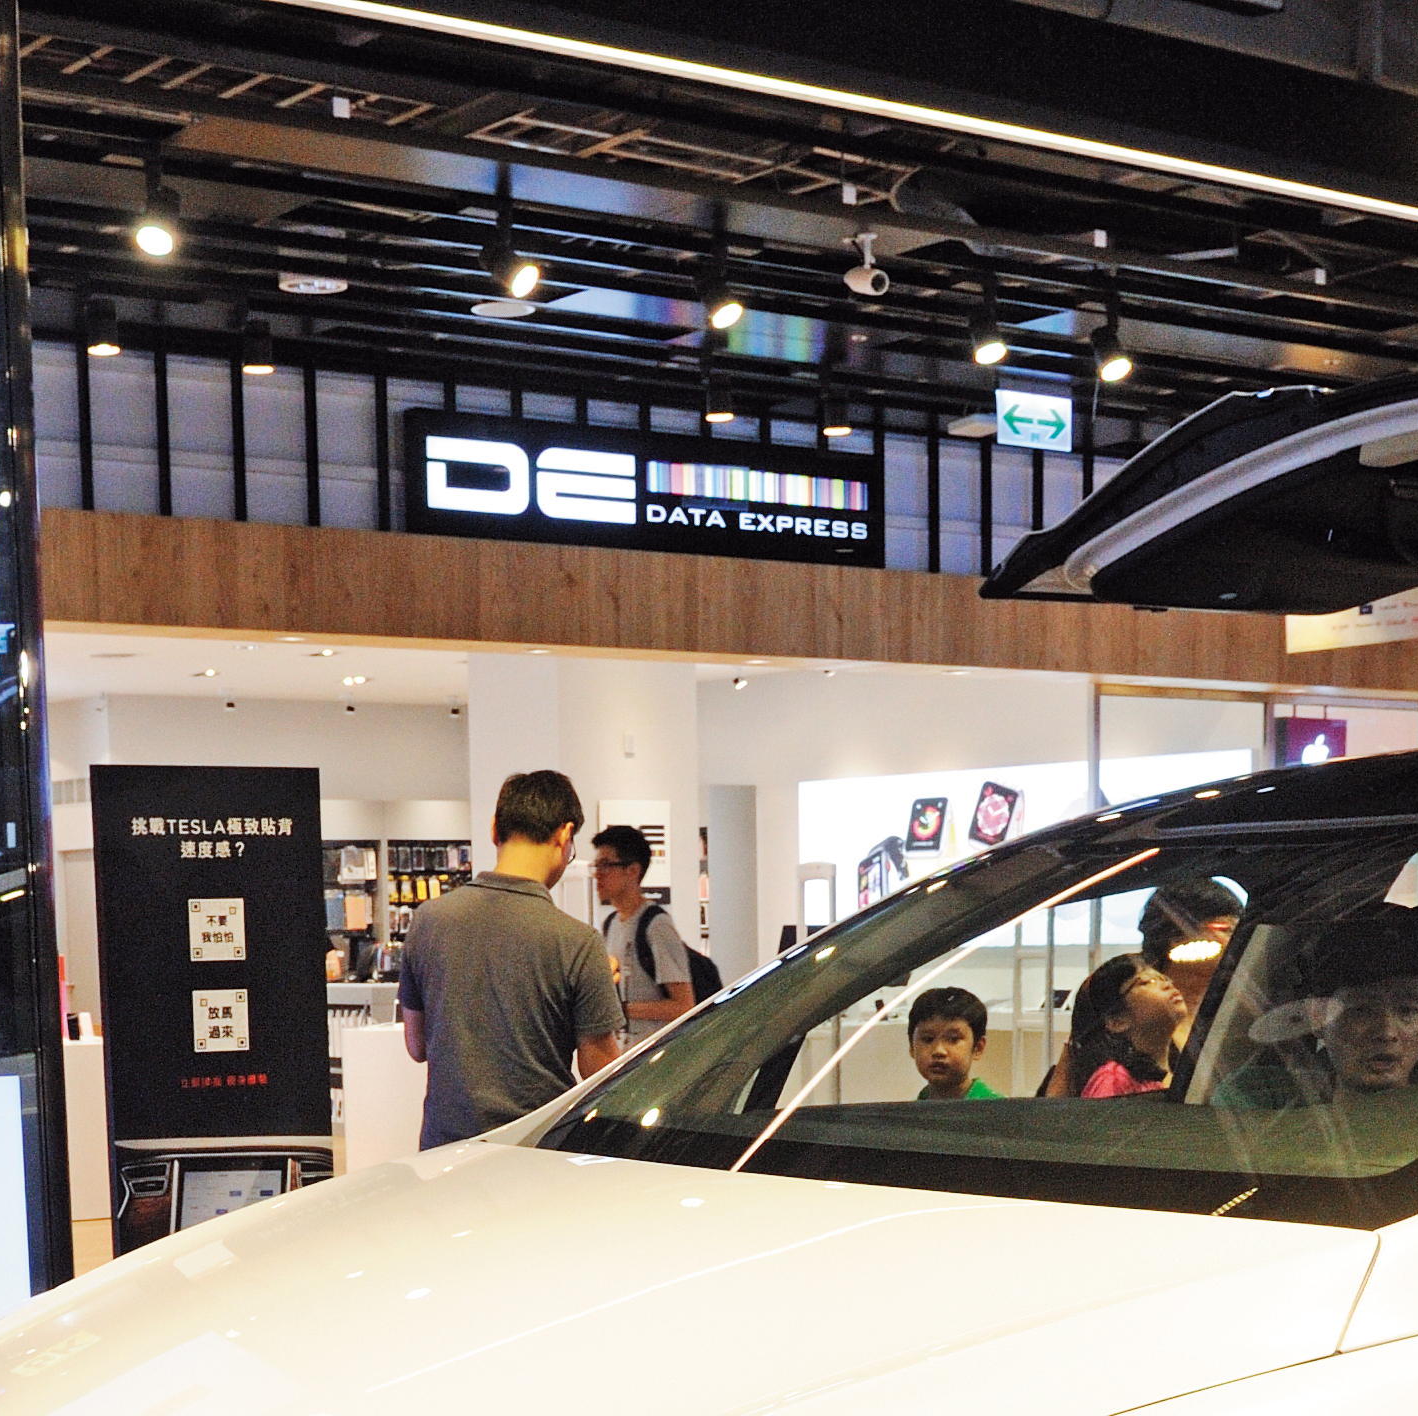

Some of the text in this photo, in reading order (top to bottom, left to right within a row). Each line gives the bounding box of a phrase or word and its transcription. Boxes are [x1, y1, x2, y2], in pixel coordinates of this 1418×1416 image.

[426, 435, 637, 525] DE
[646, 505, 868, 540] DATA EXPRESS
[131, 817, 293, 836] 挑戰TESLA極致貼背
[206, 914, 229, 927] 不要
[201, 932, 234, 944] 我怕怕
[208, 1006, 234, 1020] 放馬
[208, 1025, 235, 1039] 過來
